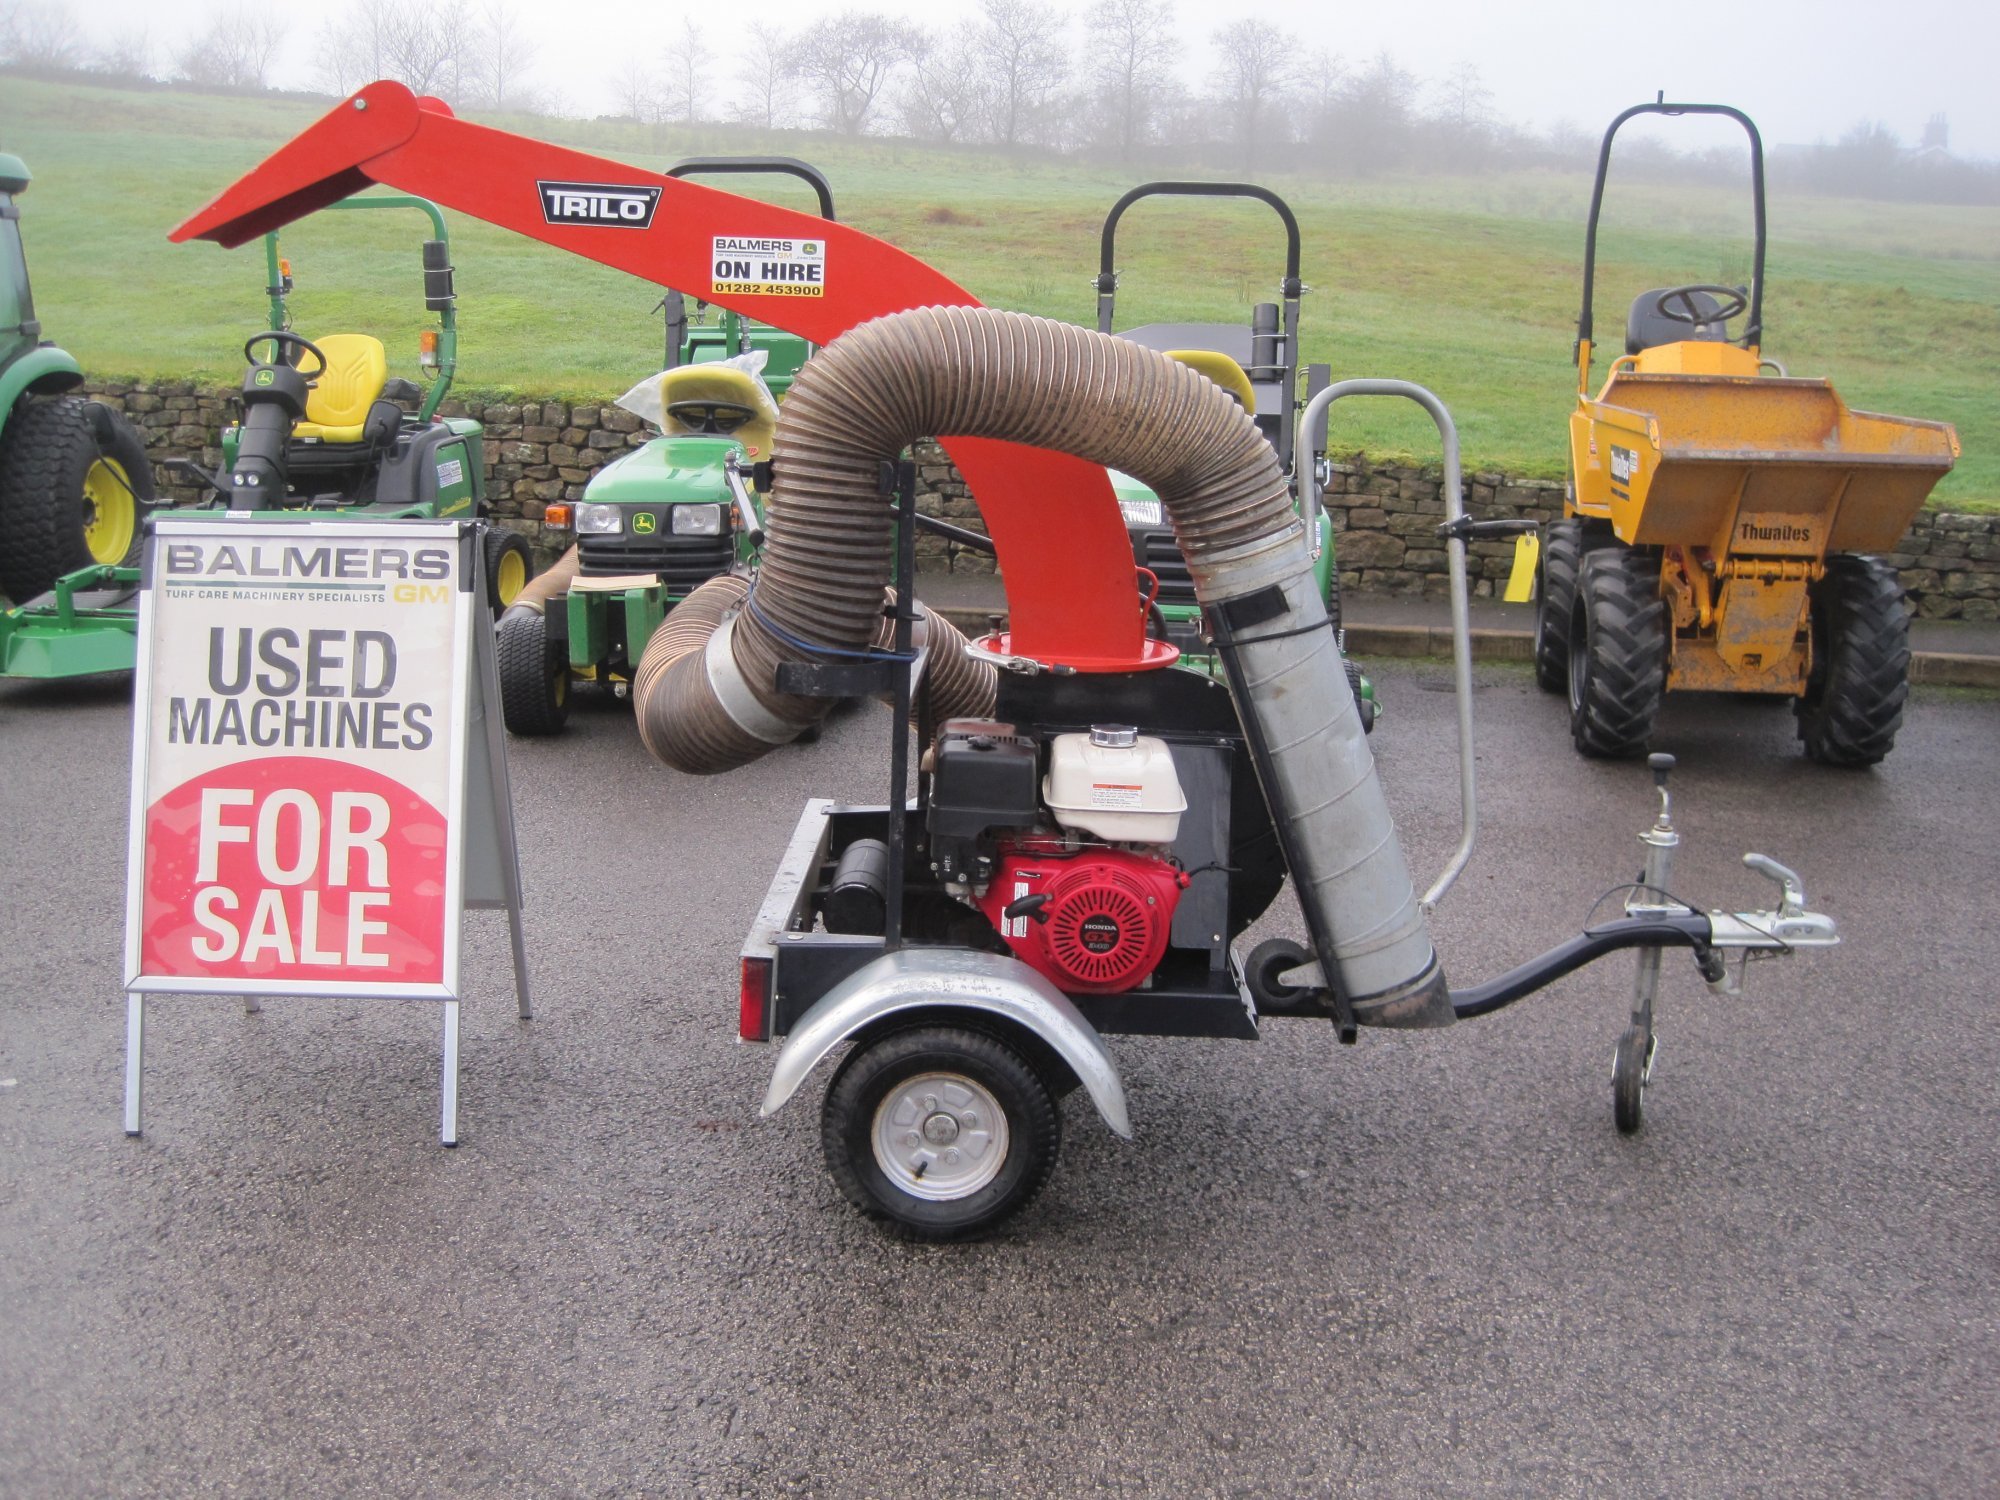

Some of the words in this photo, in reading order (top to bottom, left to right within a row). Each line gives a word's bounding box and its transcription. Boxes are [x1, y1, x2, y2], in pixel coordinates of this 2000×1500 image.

[547, 190, 650, 220] TRILO
[715, 238, 793, 252] BALMERS
[715, 260, 750, 279] ON
[761, 262, 822, 282] HIRE
[715, 283, 761, 294] 01282
[765, 285, 821, 296] 453900
[1741, 523, 1810, 542] Thwaites
[166, 544, 451, 580] BALMERS
[165, 589, 195, 599] TURF
[198, 590, 229, 600] CARE
[232, 591, 305, 601] MACHINERY
[308, 592, 385, 603] SPECIALISTS
[393, 584, 449, 604] GM
[208, 626, 398, 699] USED
[168, 697, 433, 751] MACHINES
[195, 787, 391, 888] FOR
[191, 885, 391, 967] SALE
[1084, 923, 1118, 931] HONDA
